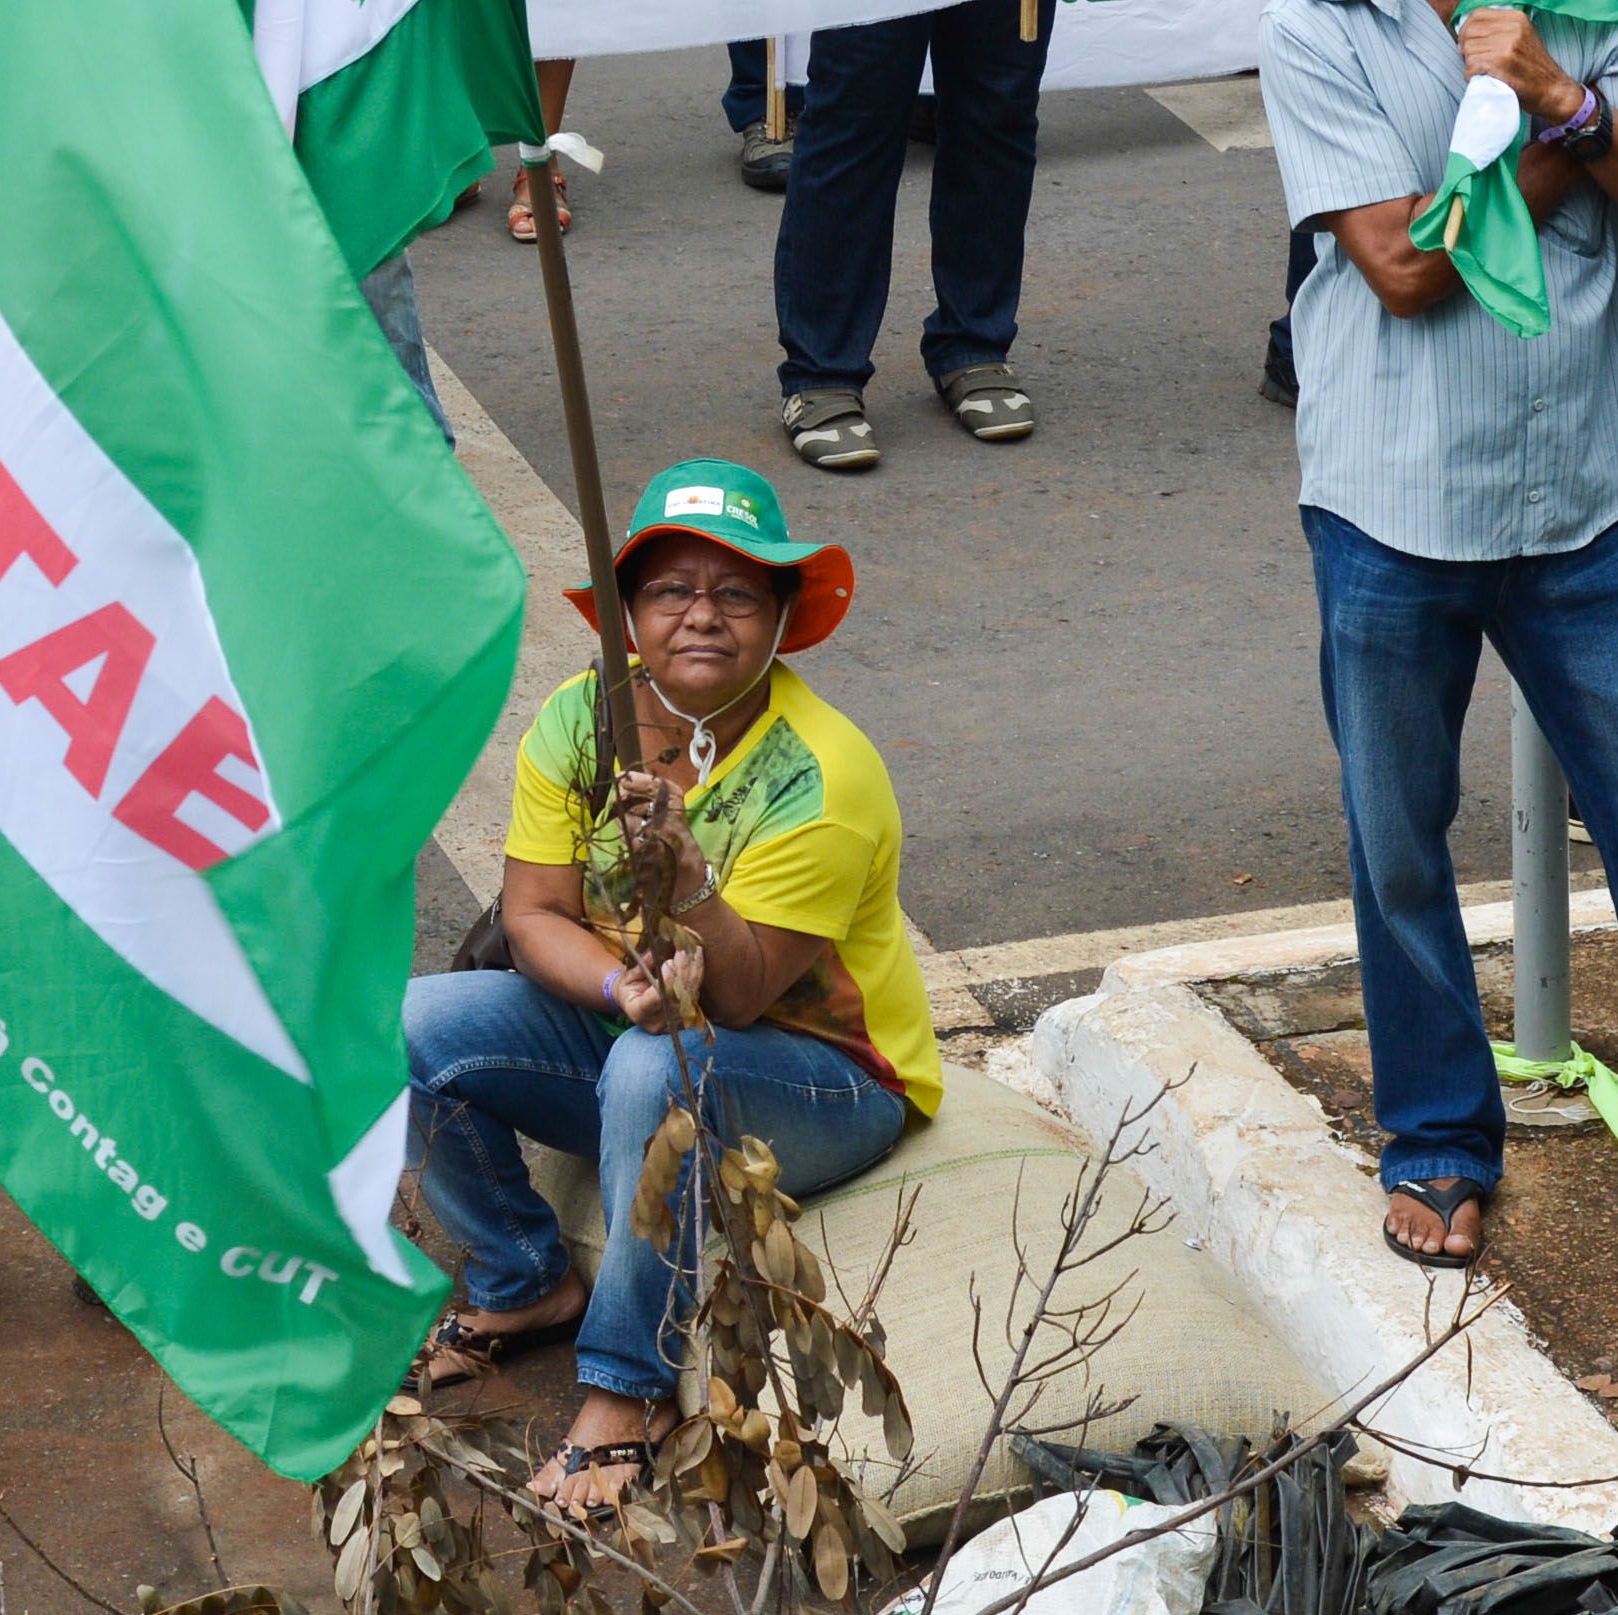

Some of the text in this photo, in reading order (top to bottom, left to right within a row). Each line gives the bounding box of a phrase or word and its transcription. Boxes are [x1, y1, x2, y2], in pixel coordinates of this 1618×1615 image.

[20, 1055, 168, 1222] Contag
[173, 1221, 208, 1254] e
[220, 1245, 341, 1306] CUT
